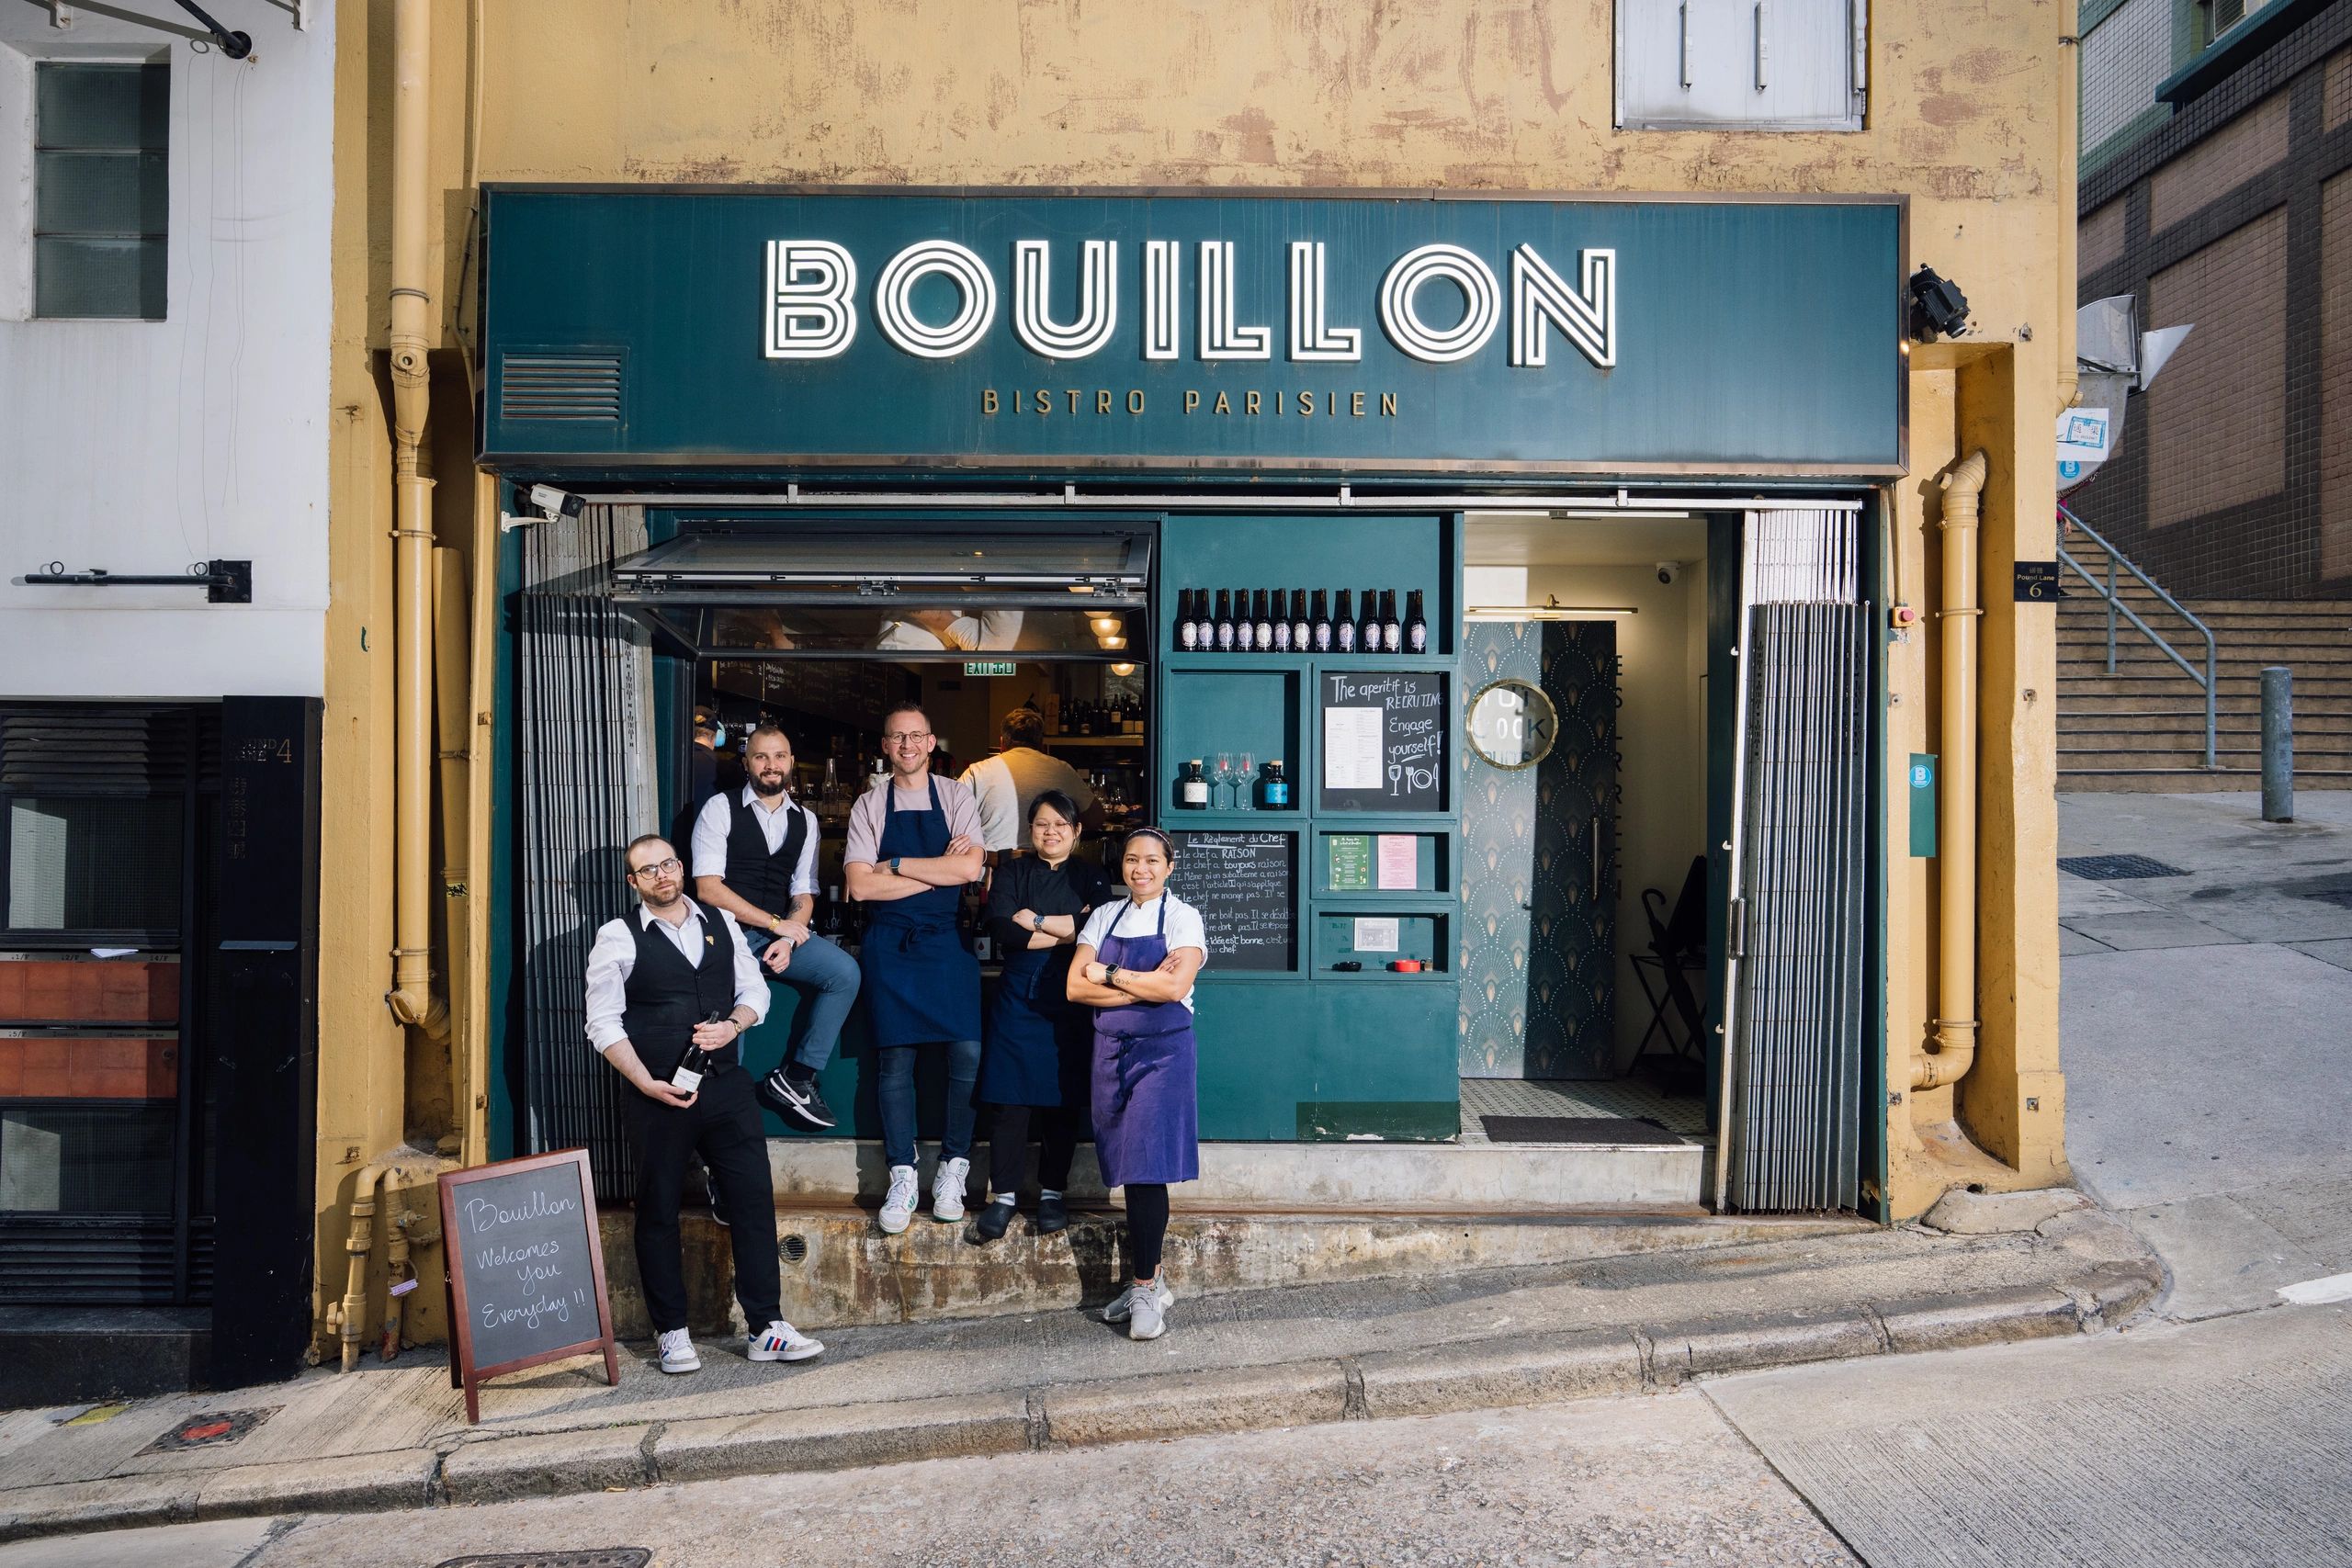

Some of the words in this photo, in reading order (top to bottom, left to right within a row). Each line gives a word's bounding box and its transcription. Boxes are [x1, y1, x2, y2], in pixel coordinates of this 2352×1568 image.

[764, 238, 1617, 367] BOUILLON
[982, 389, 1146, 415] BISTRO
[1185, 391, 1399, 417] PARISIEN
[2029, 581, 2042, 598] 6
[1329, 675, 1355, 703] The
[1359, 677, 1401, 702] aperitif
[1404, 681, 1416, 694] is
[1389, 716, 1433, 738] Engage
[277, 738, 292, 763] 4
[1387, 731, 1443, 764] yourself!
[1187, 833, 1199, 844] Le
[1203, 832, 1245, 846] Règlement
[1249, 833, 1259, 843] du
[1260, 832, 1286, 845] Chef
[1193, 847, 1210, 862] chef
[1222, 847, 1256, 859] RAISON
[1193, 858, 1212, 871] chef
[1223, 860, 1257, 874] toujours
[1182, 892, 1193, 903] Le
[1193, 889, 1210, 902] chef
[1211, 892, 1220, 900] ne
[1221, 892, 1244, 903] mange
[1208, 912, 1217, 920] ne
[1209, 923, 1217, 932] ne
[1219, 943, 1237, 954] chef
[464, 1190, 577, 1234] Bouillon
[475, 1239, 560, 1270] Welcomes
[481, 1294, 569, 1330] Everyday
[572, 1288, 586, 1309] !!
